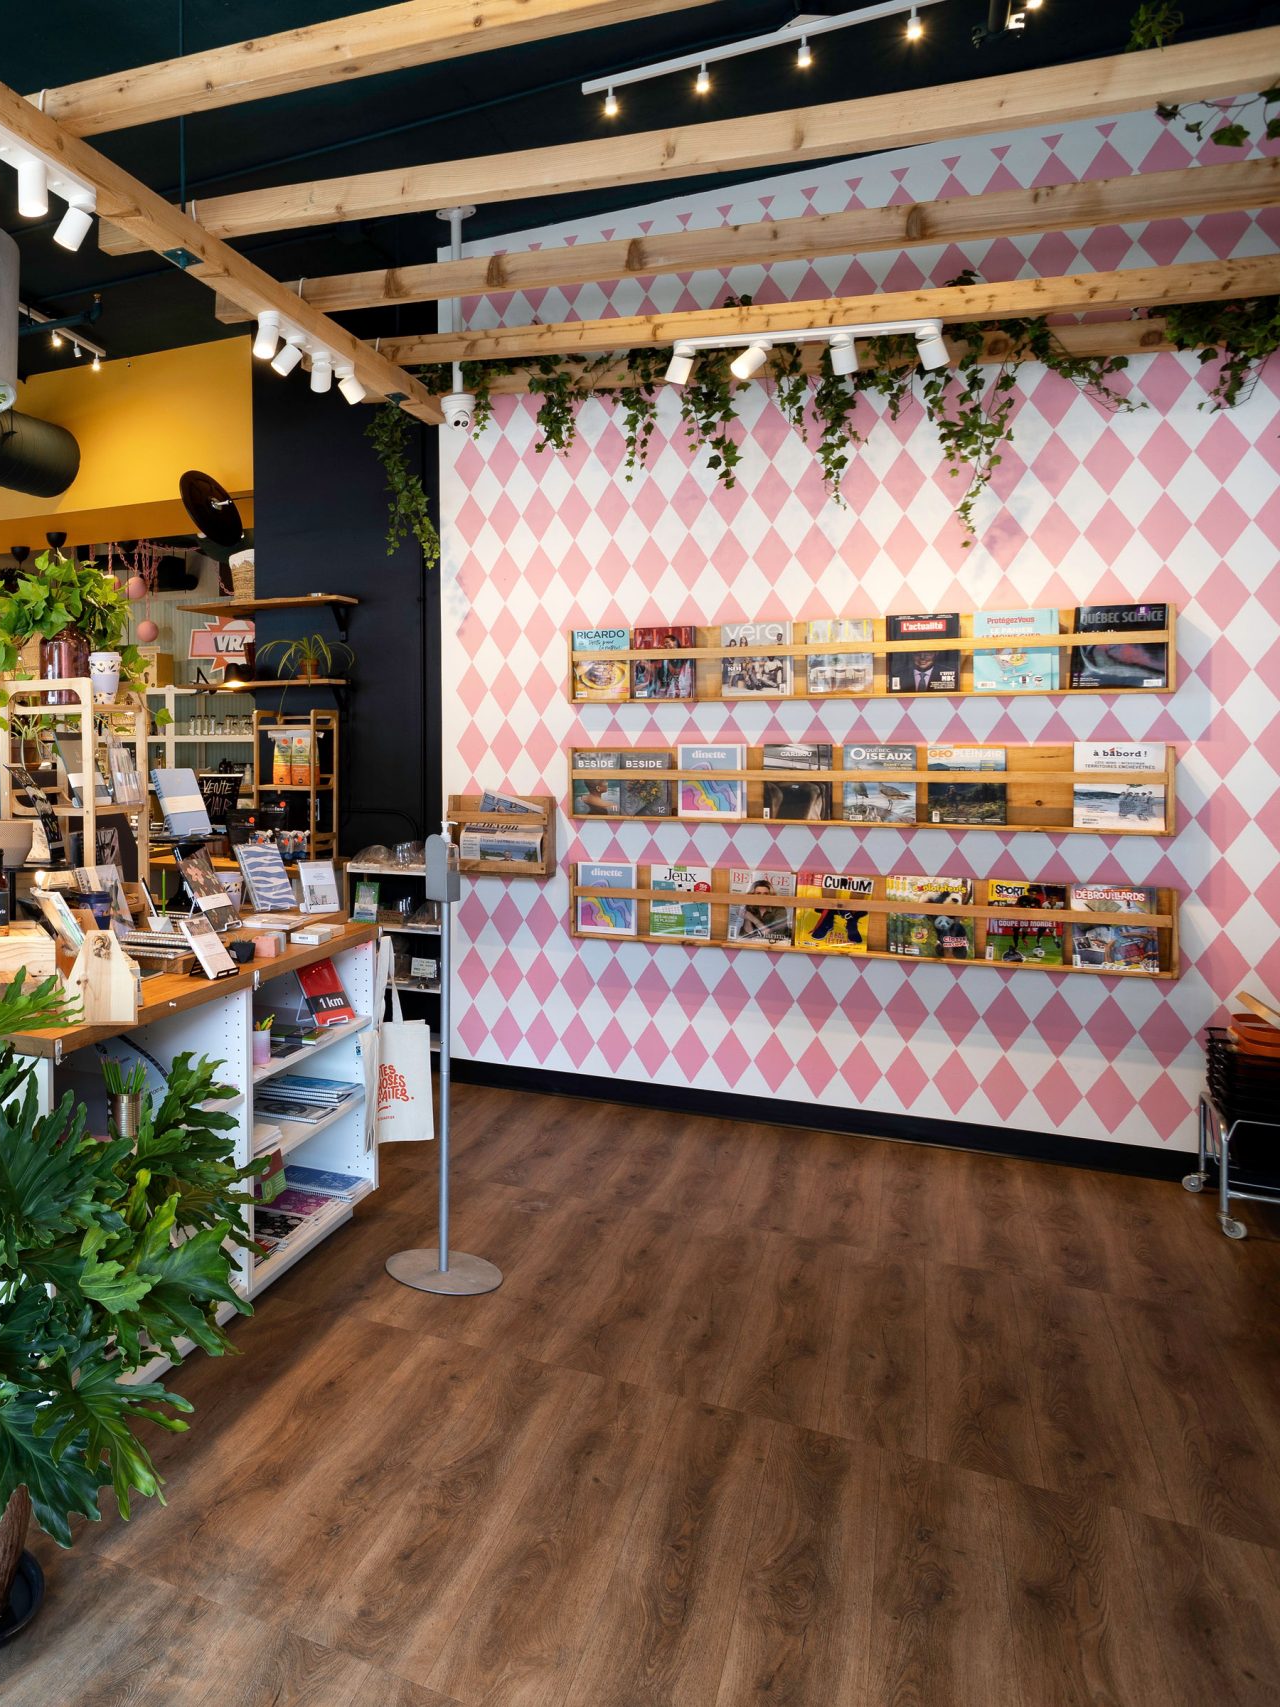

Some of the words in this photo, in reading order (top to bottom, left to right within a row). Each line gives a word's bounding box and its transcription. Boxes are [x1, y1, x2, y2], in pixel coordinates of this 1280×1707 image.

[1082, 612, 1119, 625] QUÉBEC
[903, 622, 943, 632] L'actualité
[576, 630, 624, 639] RICARDO
[214, 635, 254, 652] VRA
[692, 750, 726, 759] dinette
[850, 748, 912, 760] OISEAUX
[203, 780, 232, 794] VENTE
[591, 868, 624, 877] dinette
[664, 868, 696, 882] Jeux
[996, 884, 1024, 896] SPORT
[320, 998, 326, 1008] 1
[326, 996, 344, 1008] km
